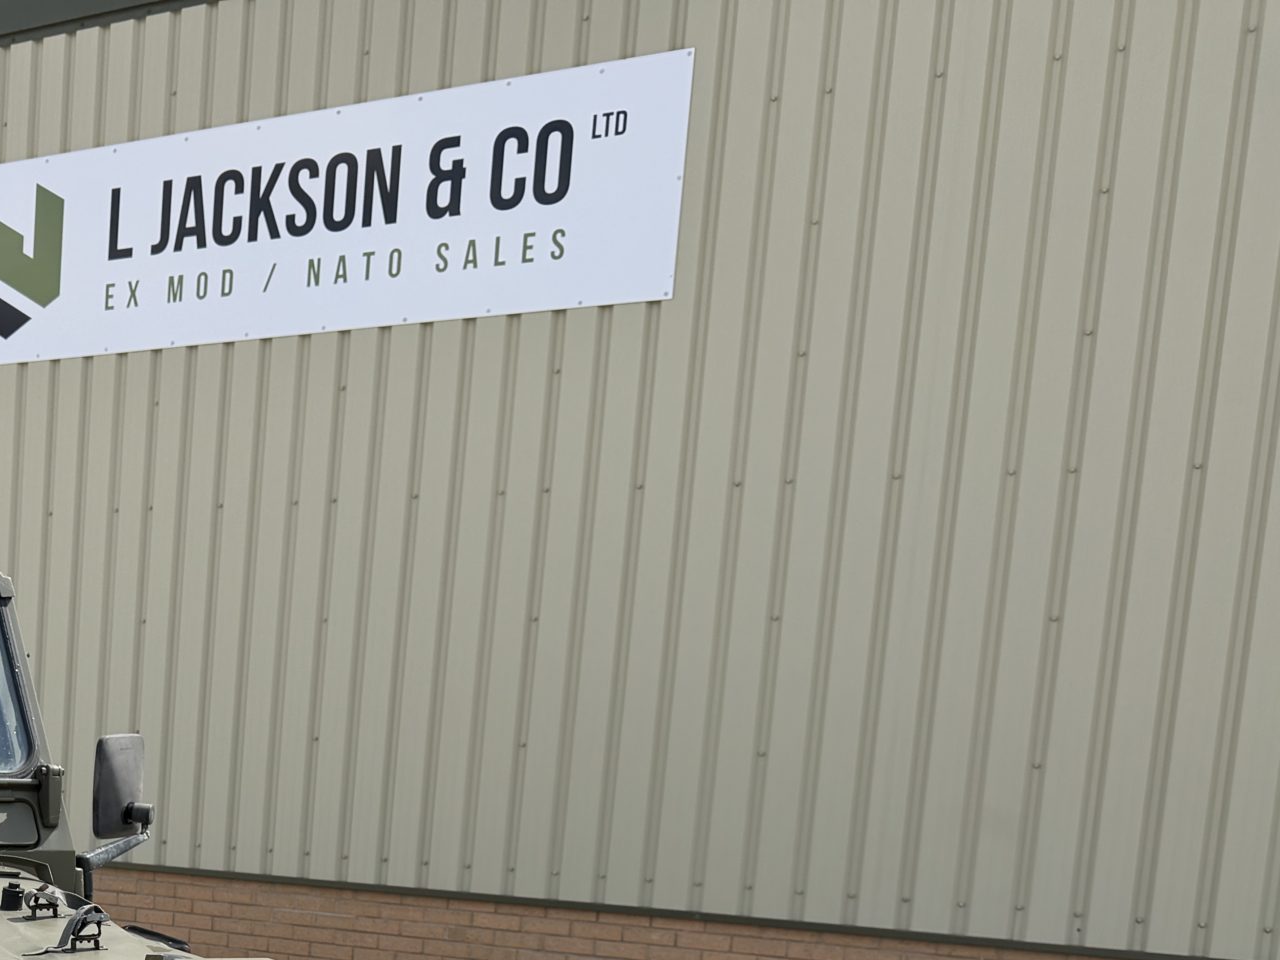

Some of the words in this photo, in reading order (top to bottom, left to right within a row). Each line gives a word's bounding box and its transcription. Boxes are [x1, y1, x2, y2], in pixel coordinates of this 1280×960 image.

[108, 187, 133, 261] L
[150, 144, 402, 256] JACKSON
[425, 135, 466, 219] &
[489, 119, 574, 211] CO
[591, 110, 628, 139] LTD
[105, 279, 139, 310] EX
[167, 268, 234, 304] MOD
[306, 248, 402, 288] NATO
[435, 228, 566, 273] SALES
